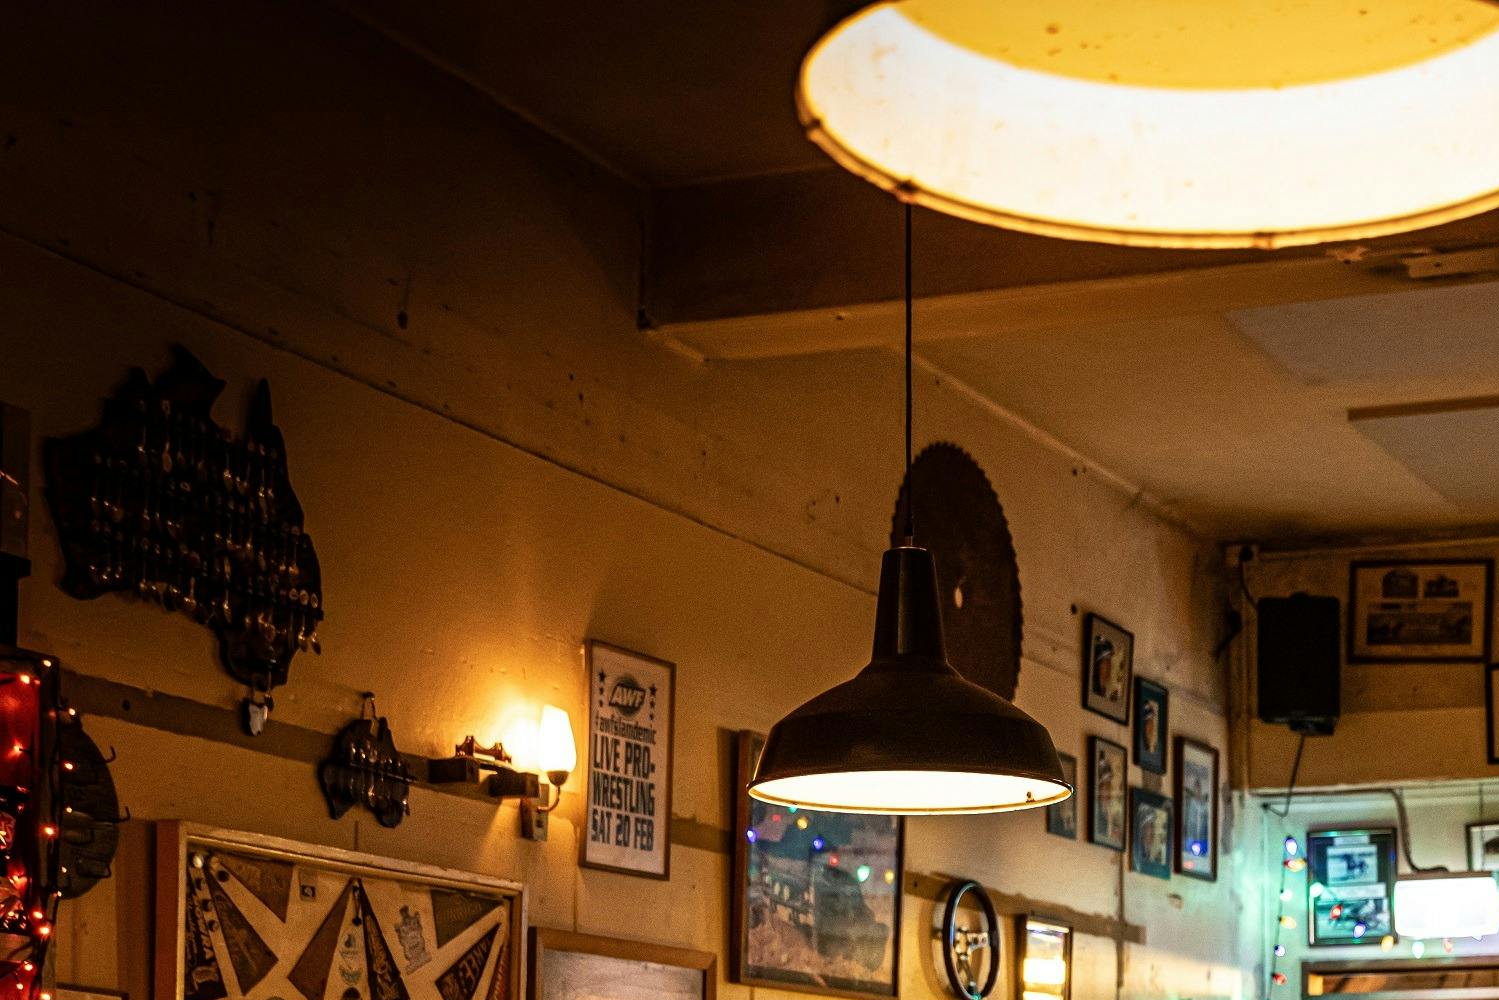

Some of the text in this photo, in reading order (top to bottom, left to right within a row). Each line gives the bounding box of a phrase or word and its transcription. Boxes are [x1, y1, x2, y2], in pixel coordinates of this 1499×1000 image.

[612, 685, 645, 707] AWF
[593, 734, 656, 780] LIVE PRO-
[592, 770, 656, 817] WRESTLING
[591, 808, 654, 852] SAT 20 FEB
